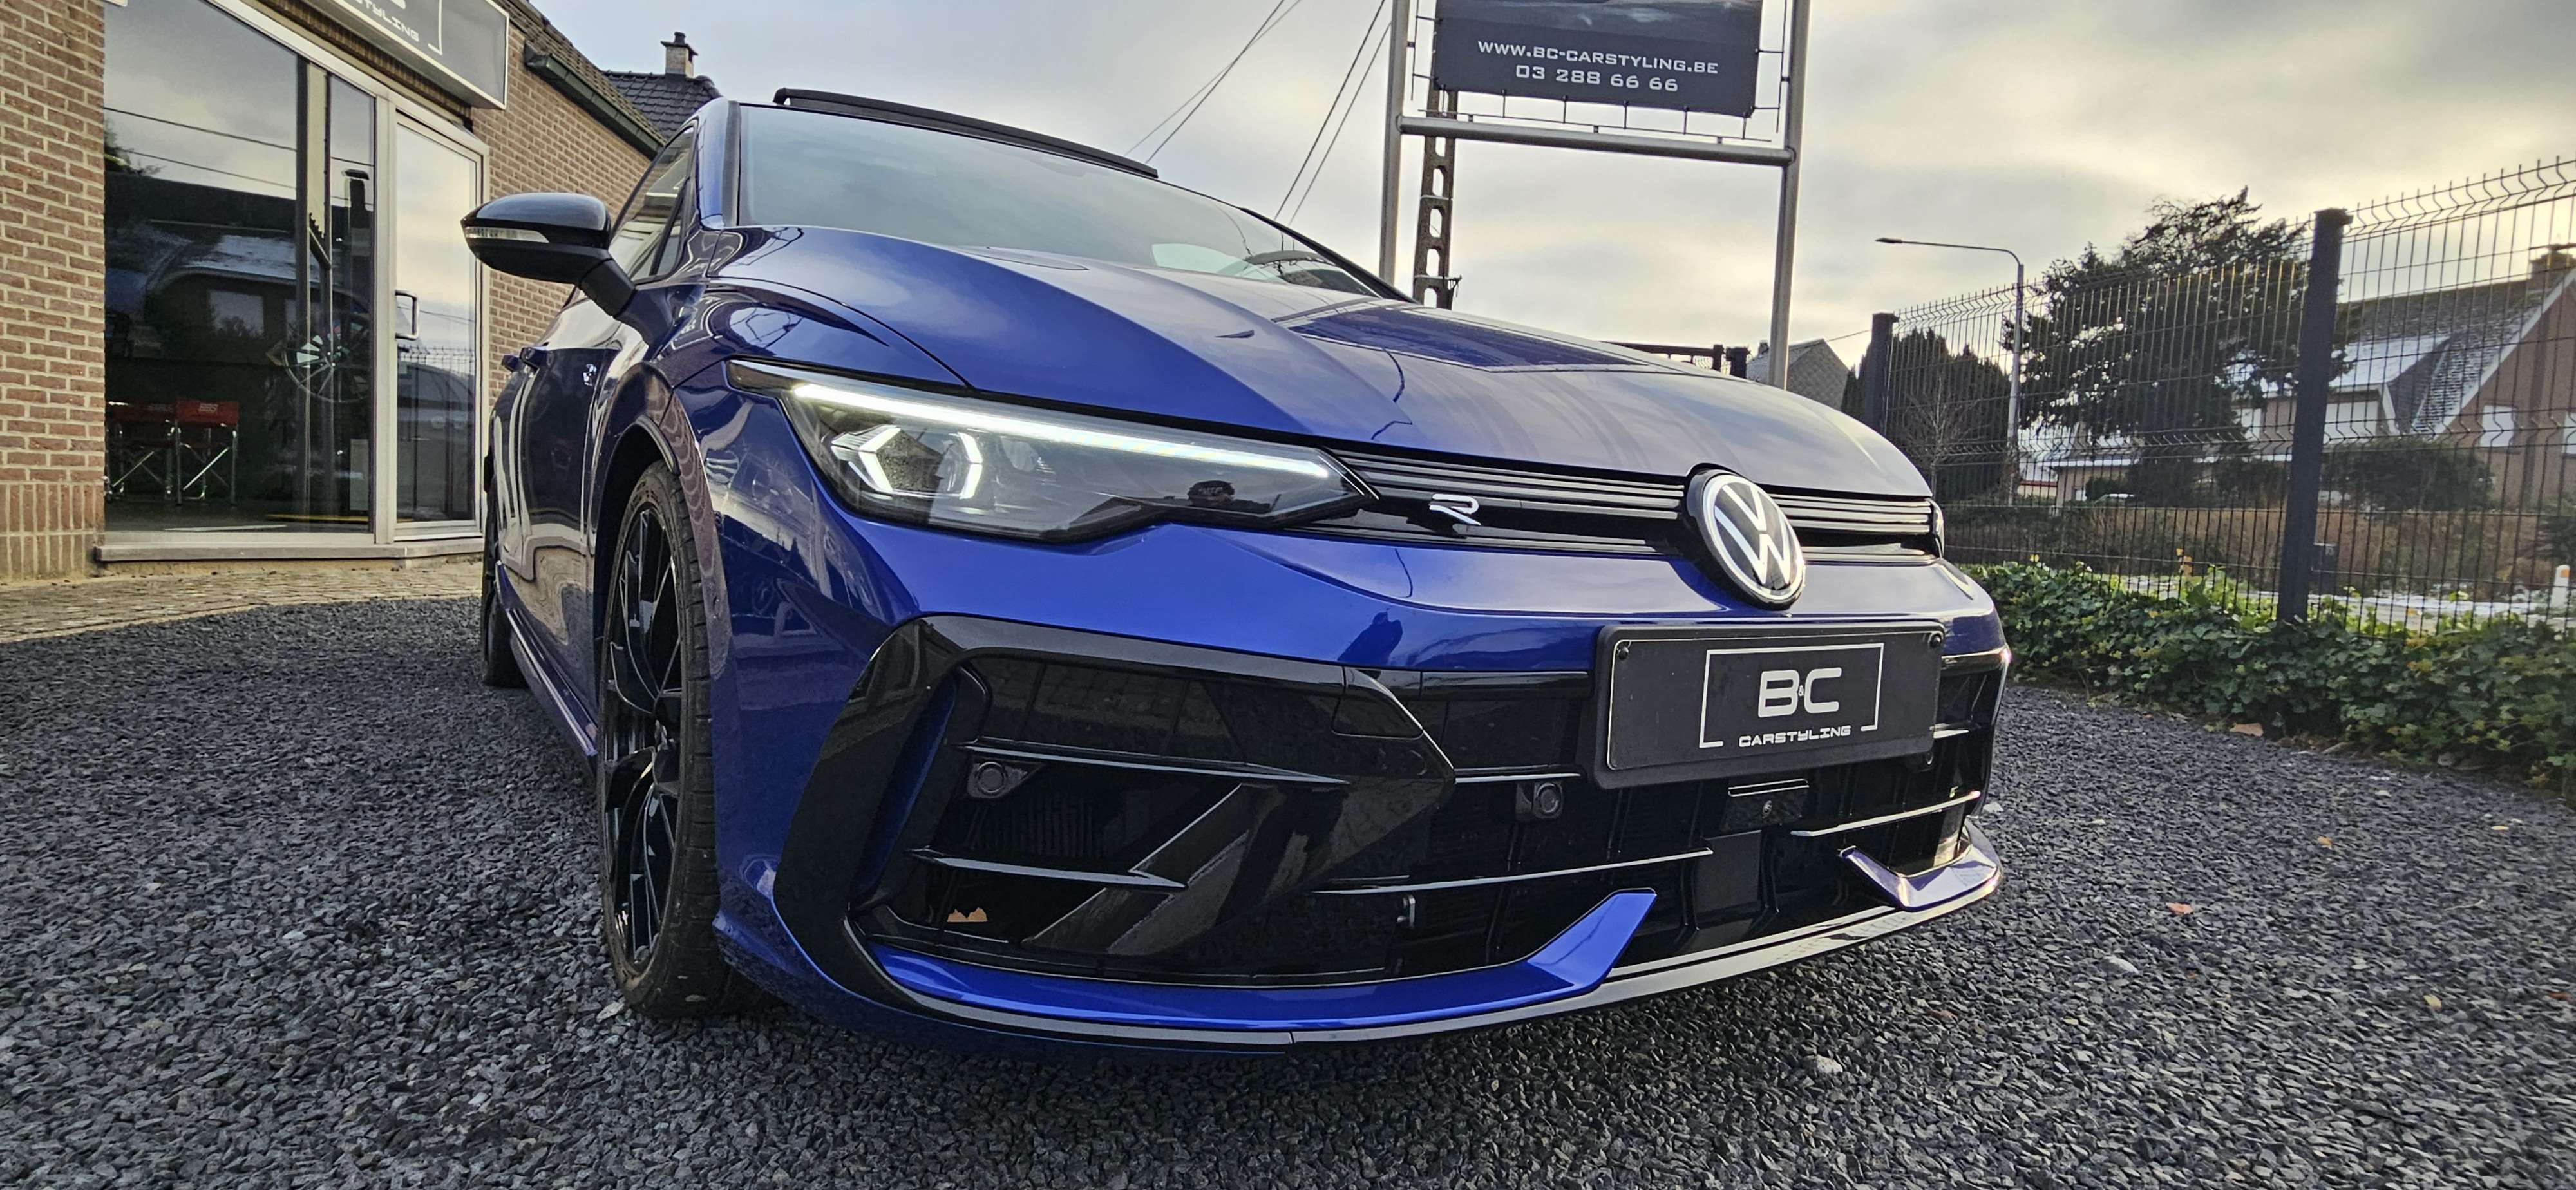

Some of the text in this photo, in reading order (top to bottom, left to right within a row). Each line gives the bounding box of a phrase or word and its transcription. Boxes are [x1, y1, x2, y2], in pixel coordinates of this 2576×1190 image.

[1477, 41, 1719, 74] WWW.BC-CARSTYLING.BE
[1515, 64, 1678, 92] 03 288 66 66
[1429, 493, 1481, 526] R
[1739, 725, 1852, 748] CARSTYLING
